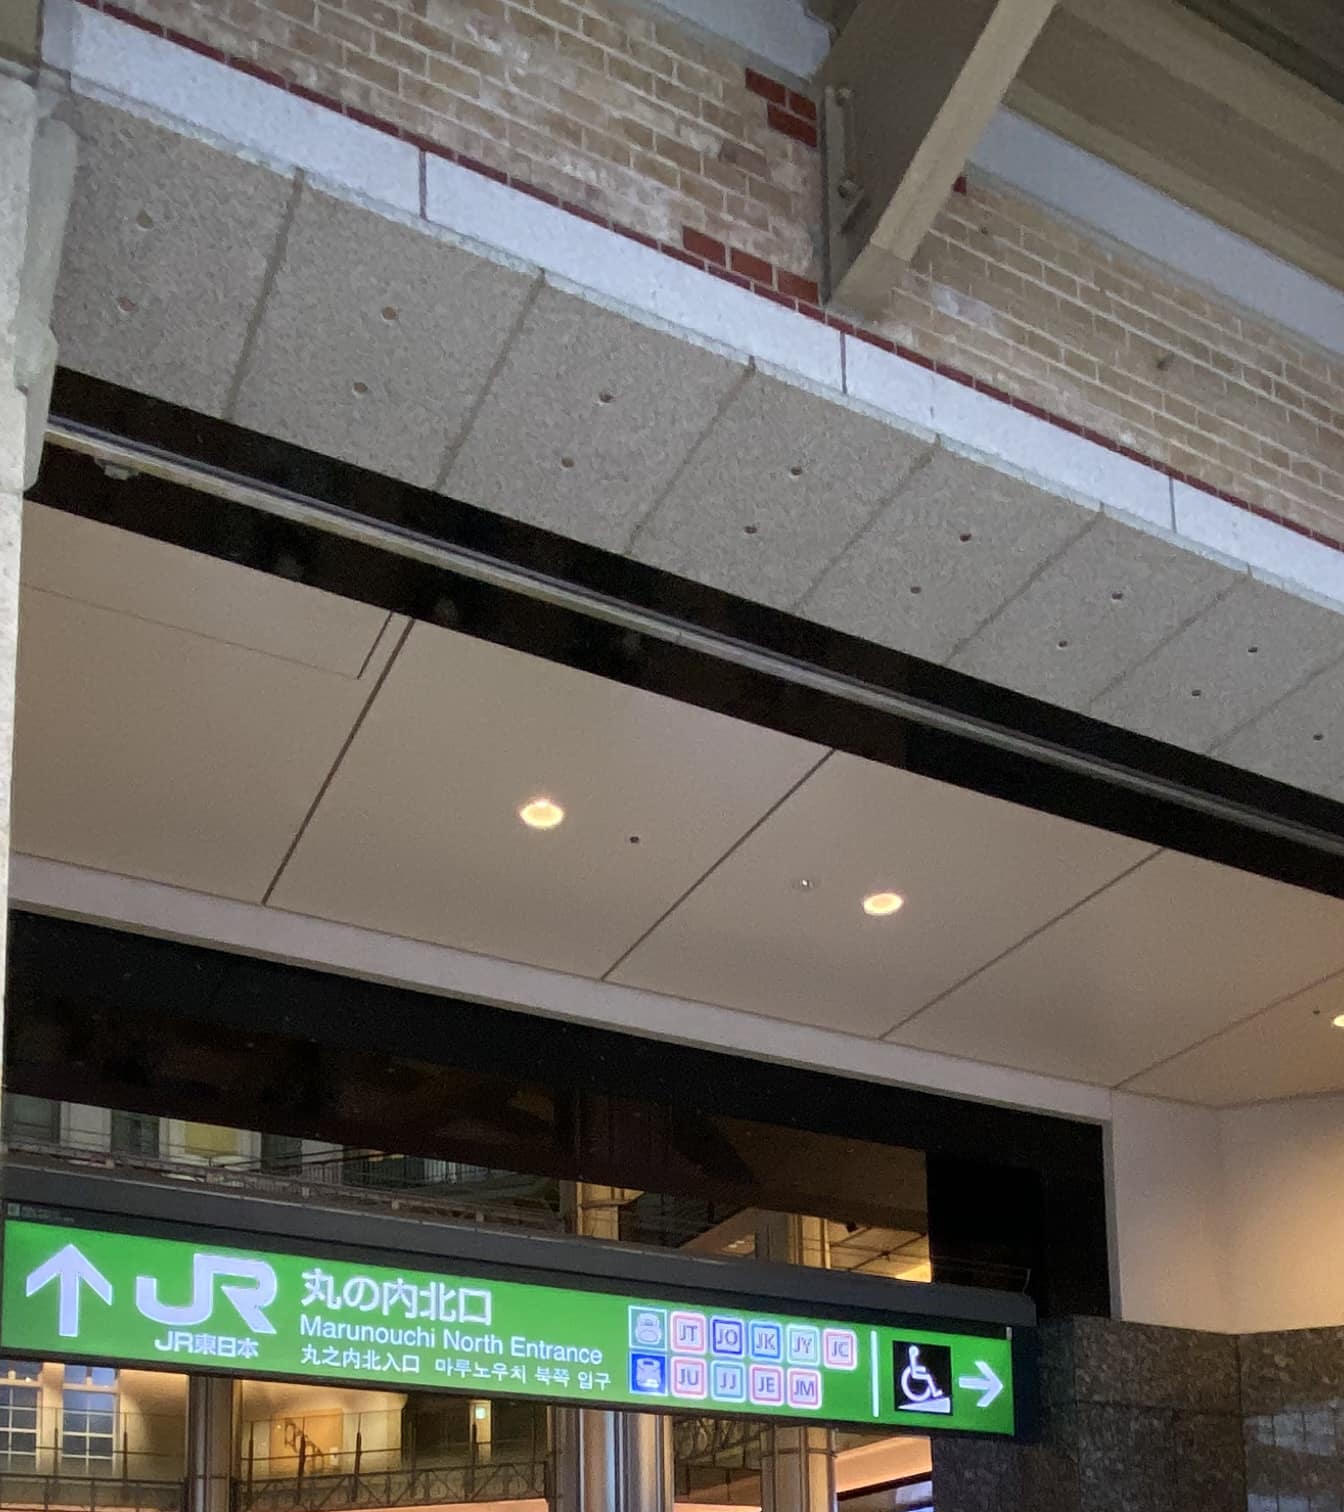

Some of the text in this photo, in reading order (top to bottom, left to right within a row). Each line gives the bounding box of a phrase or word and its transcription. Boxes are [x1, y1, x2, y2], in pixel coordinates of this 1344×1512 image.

[135, 1253, 277, 1334] JR
[301, 1268, 492, 1326] 丸の内北口
[154, 1331, 259, 1358] JR東日本
[300, 1314, 603, 1365] Marunouchi North Entrance
[679, 1324, 849, 1358] JT JO JK JY JC
[300, 1343, 420, 1374] 丸之内北入口
[435, 1357, 611, 1391] 마루노우치 북쪽 입구
[678, 1368, 814, 1397] JU JJ JE JM
